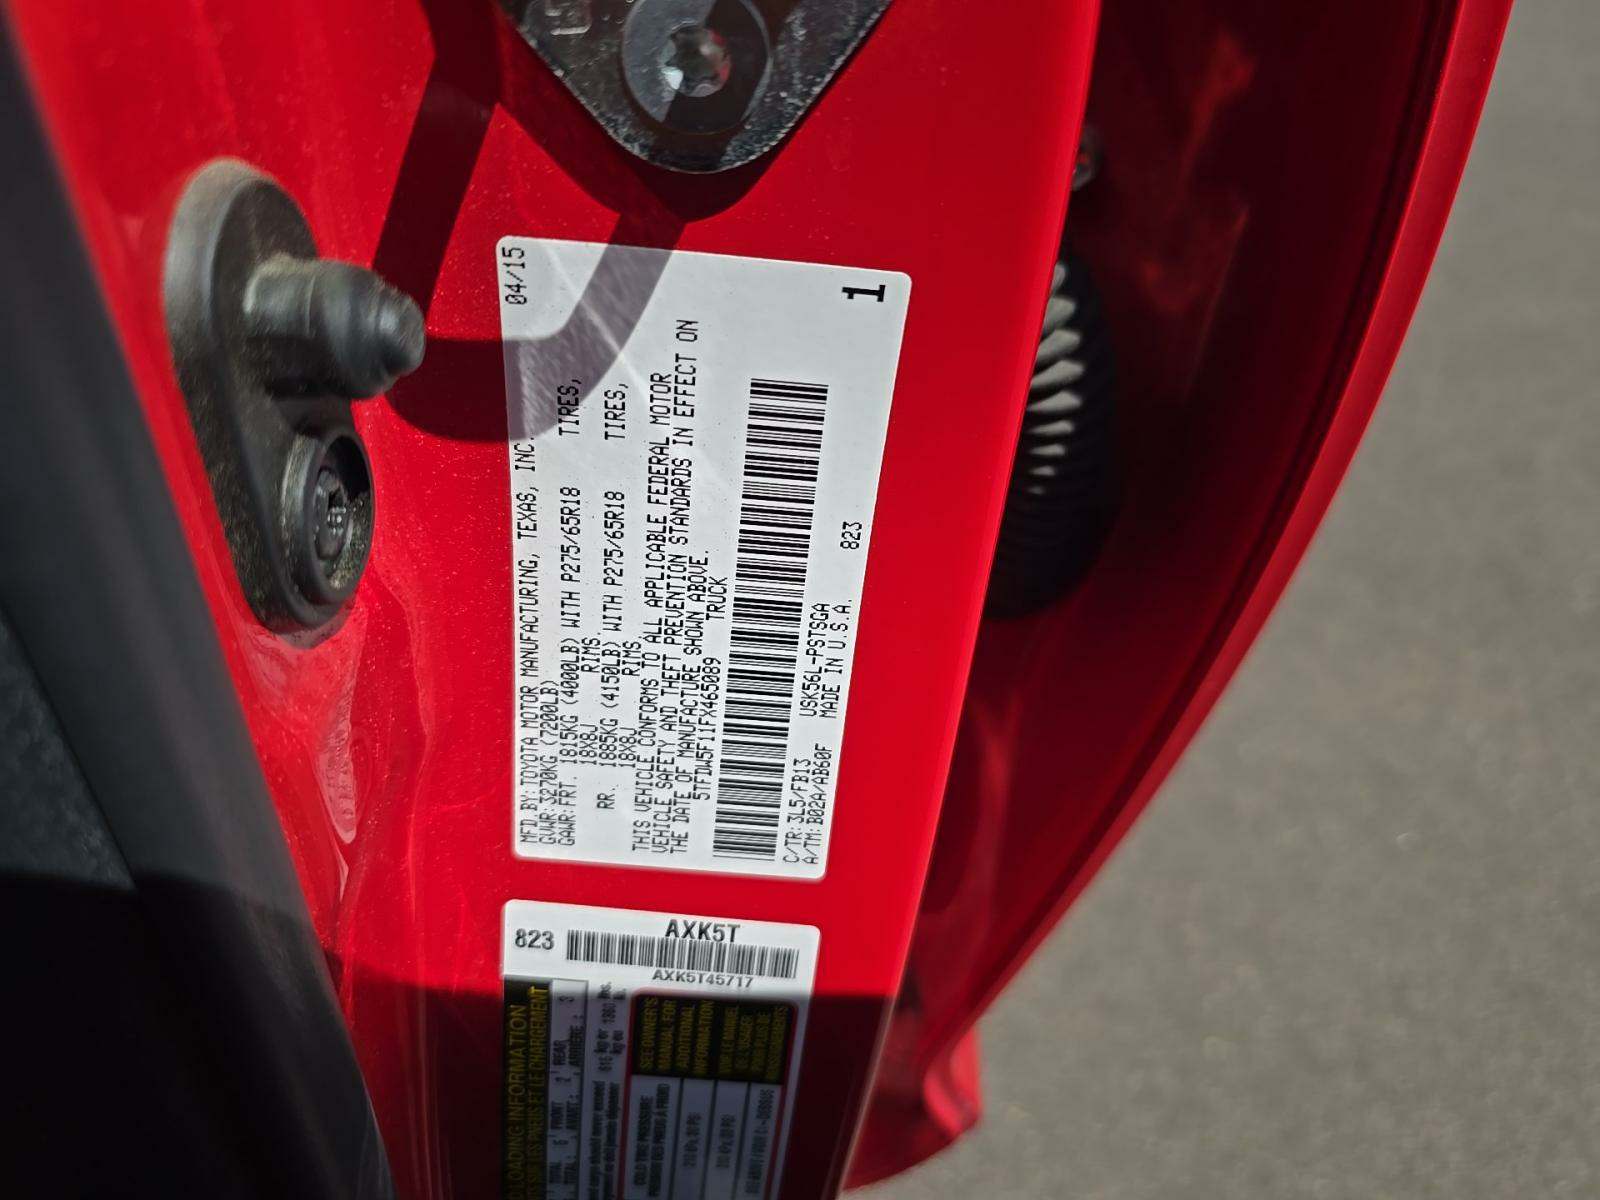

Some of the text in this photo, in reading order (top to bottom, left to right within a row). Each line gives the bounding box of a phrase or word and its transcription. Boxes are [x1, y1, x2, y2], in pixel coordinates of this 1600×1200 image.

[502, 246, 527, 304] 04/15
[842, 284, 886, 302] 1
[558, 379, 581, 435] TIRES,
[514, 437, 535, 472] INC.
[516, 486, 538, 539] TEXAS,
[560, 487, 580, 582] P275/65R18
[840, 521, 862, 550] 823
[518, 553, 539, 677] MANUFACTURING,
[560, 591, 580, 627] WITH
[598, 383, 628, 809] RR. 1885KG (4150LB) WITH P275/65R18 TIRES,
[633, 372, 671, 851] THIS VEHICLE CONFORMS TO ALL APPLICABLE FEDERAL MOTOR
[652, 320, 698, 853] VEHICLE SAFETY AND THEFT PREVENTION STANDARDS IN EFFECT ON
[829, 600, 852, 649] U.S.A.
[561, 638, 579, 704] (4000LB)
[693, 576, 728, 800] 5TFDW5F11FX465089 TRUCK
[799, 603, 829, 717] USK56L-PSTSGA
[824, 658, 844, 674] IN
[520, 686, 538, 728] MOTOR
[540, 680, 558, 745] (7200LB)
[580, 632, 600, 765] 18X8J RIMS.
[619, 635, 642, 768] 18X8J RIMS.
[670, 550, 709, 854] THE DATE OF MANUFACTURE SHOWN ABOVE.
[820, 684, 841, 718] MADE
[560, 715, 578, 764] 1815KG
[514, 928, 555, 950] 823
[665, 919, 741, 943] AXK5T
[652, 969, 753, 988] AXK5T45717
[528, 986, 548, 1070] CHARGEMENT
[553, 1040, 566, 1066] REAR
[640, 996, 659, 1070] SEE OWNER'S
[658, 1000, 677, 1070] MANUAL FOR
[676, 1004, 695, 1068] ADDITIONAL
[694, 1000, 715, 1074] INFORMATION
[508, 1004, 528, 1120] INFORMATION
